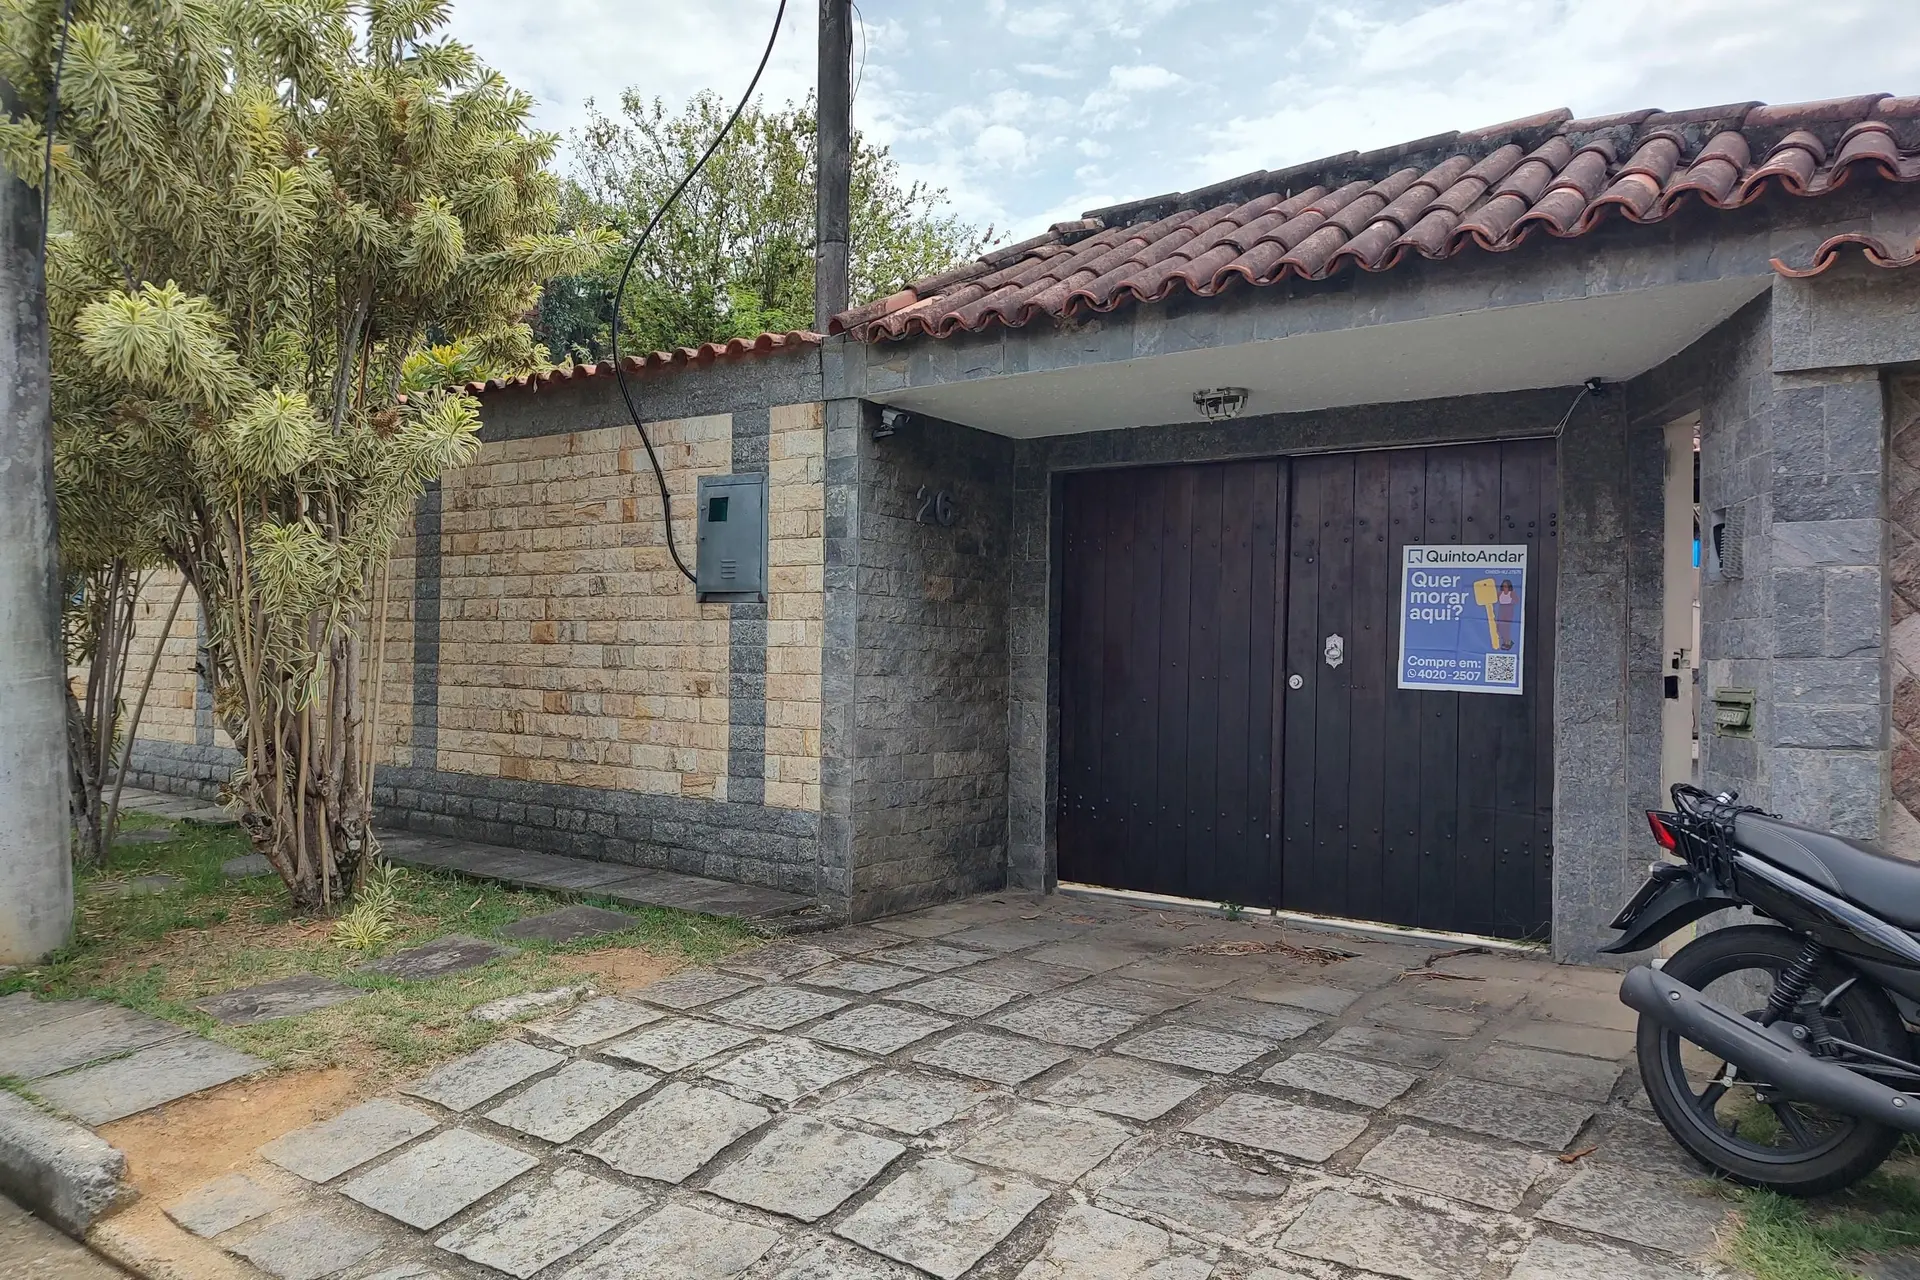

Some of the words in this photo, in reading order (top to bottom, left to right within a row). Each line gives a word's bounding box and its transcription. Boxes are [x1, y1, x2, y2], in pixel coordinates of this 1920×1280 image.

[916, 484, 954, 526] 26
[1426, 550, 1525, 563] QuintoAndar
[1411, 571, 1461, 588] Quer
[1410, 591, 1469, 605] morar
[1409, 605, 1464, 624] aqui?
[1407, 655, 1457, 669] Compre
[1458, 659, 1482, 669] em:
[1417, 669, 1481, 681] 4020-2507
